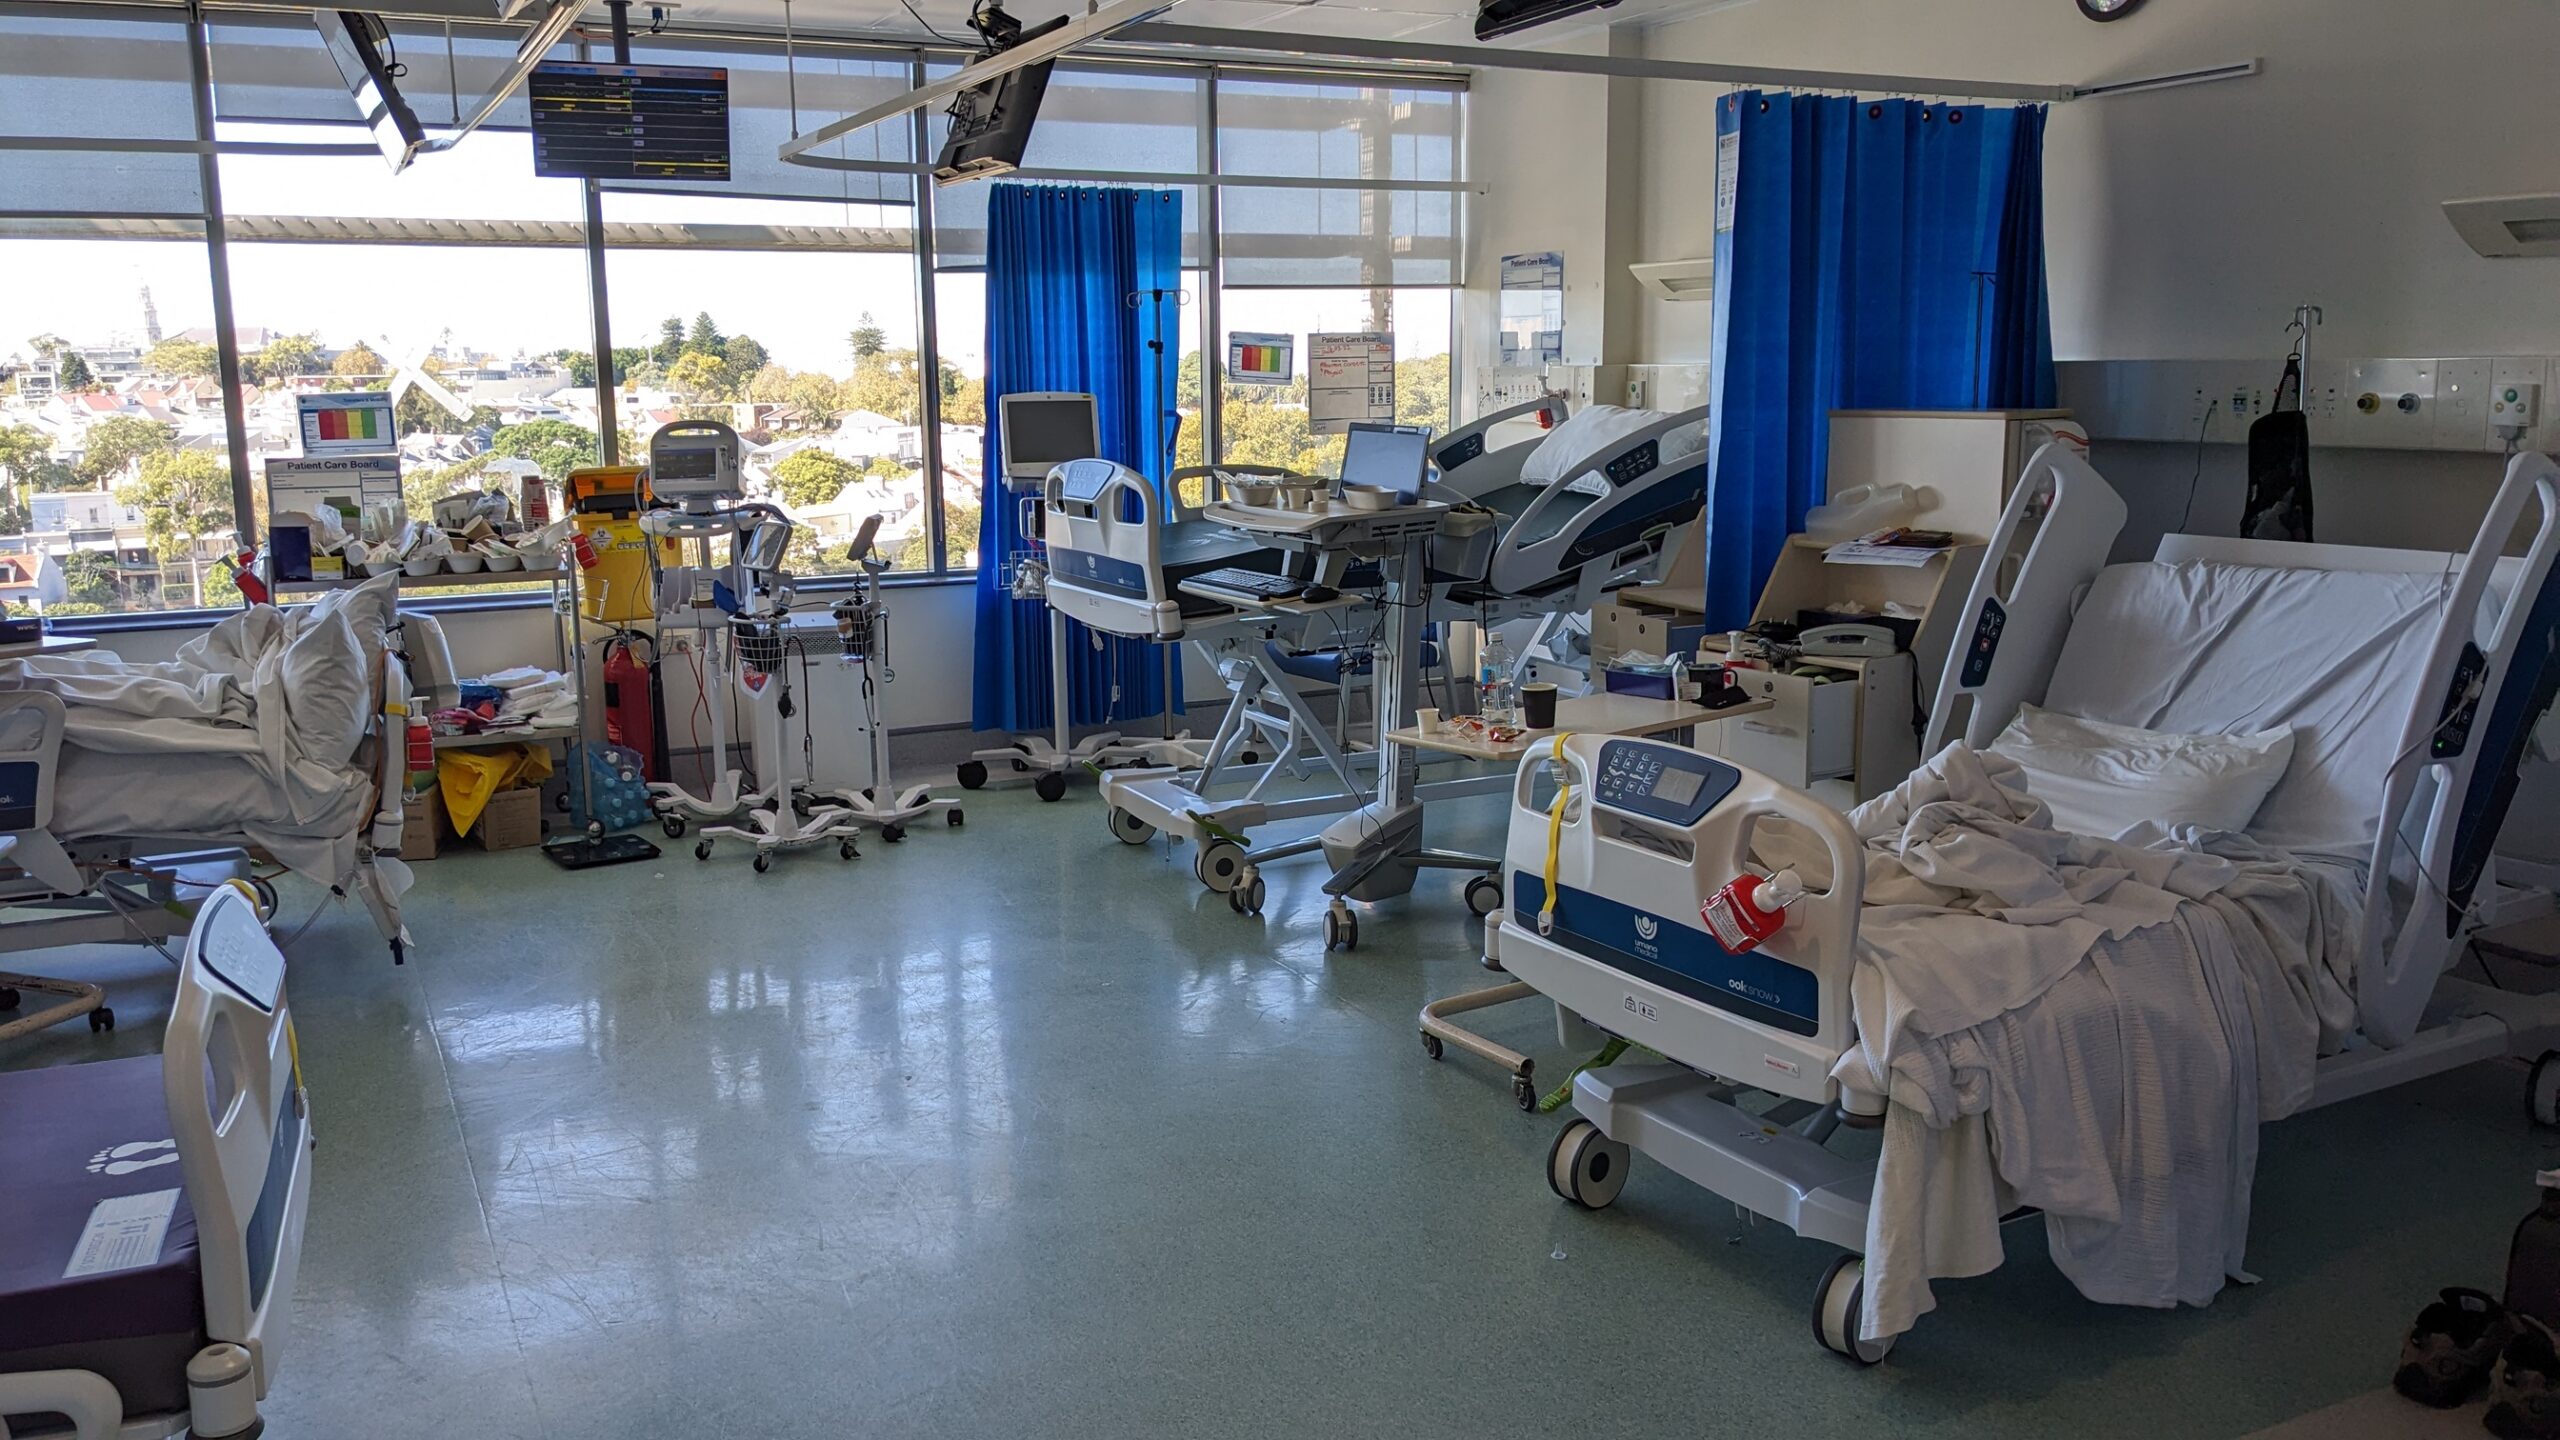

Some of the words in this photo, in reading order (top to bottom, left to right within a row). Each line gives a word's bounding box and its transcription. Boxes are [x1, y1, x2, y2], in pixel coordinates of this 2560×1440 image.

[1527, 258, 1538, 266] Care
[287, 460, 322, 470] Patient
[324, 461, 347, 469] Care
[350, 460, 379, 469] Board
[1634, 939, 1658, 953] umano
[1634, 946, 1658, 960] medical
